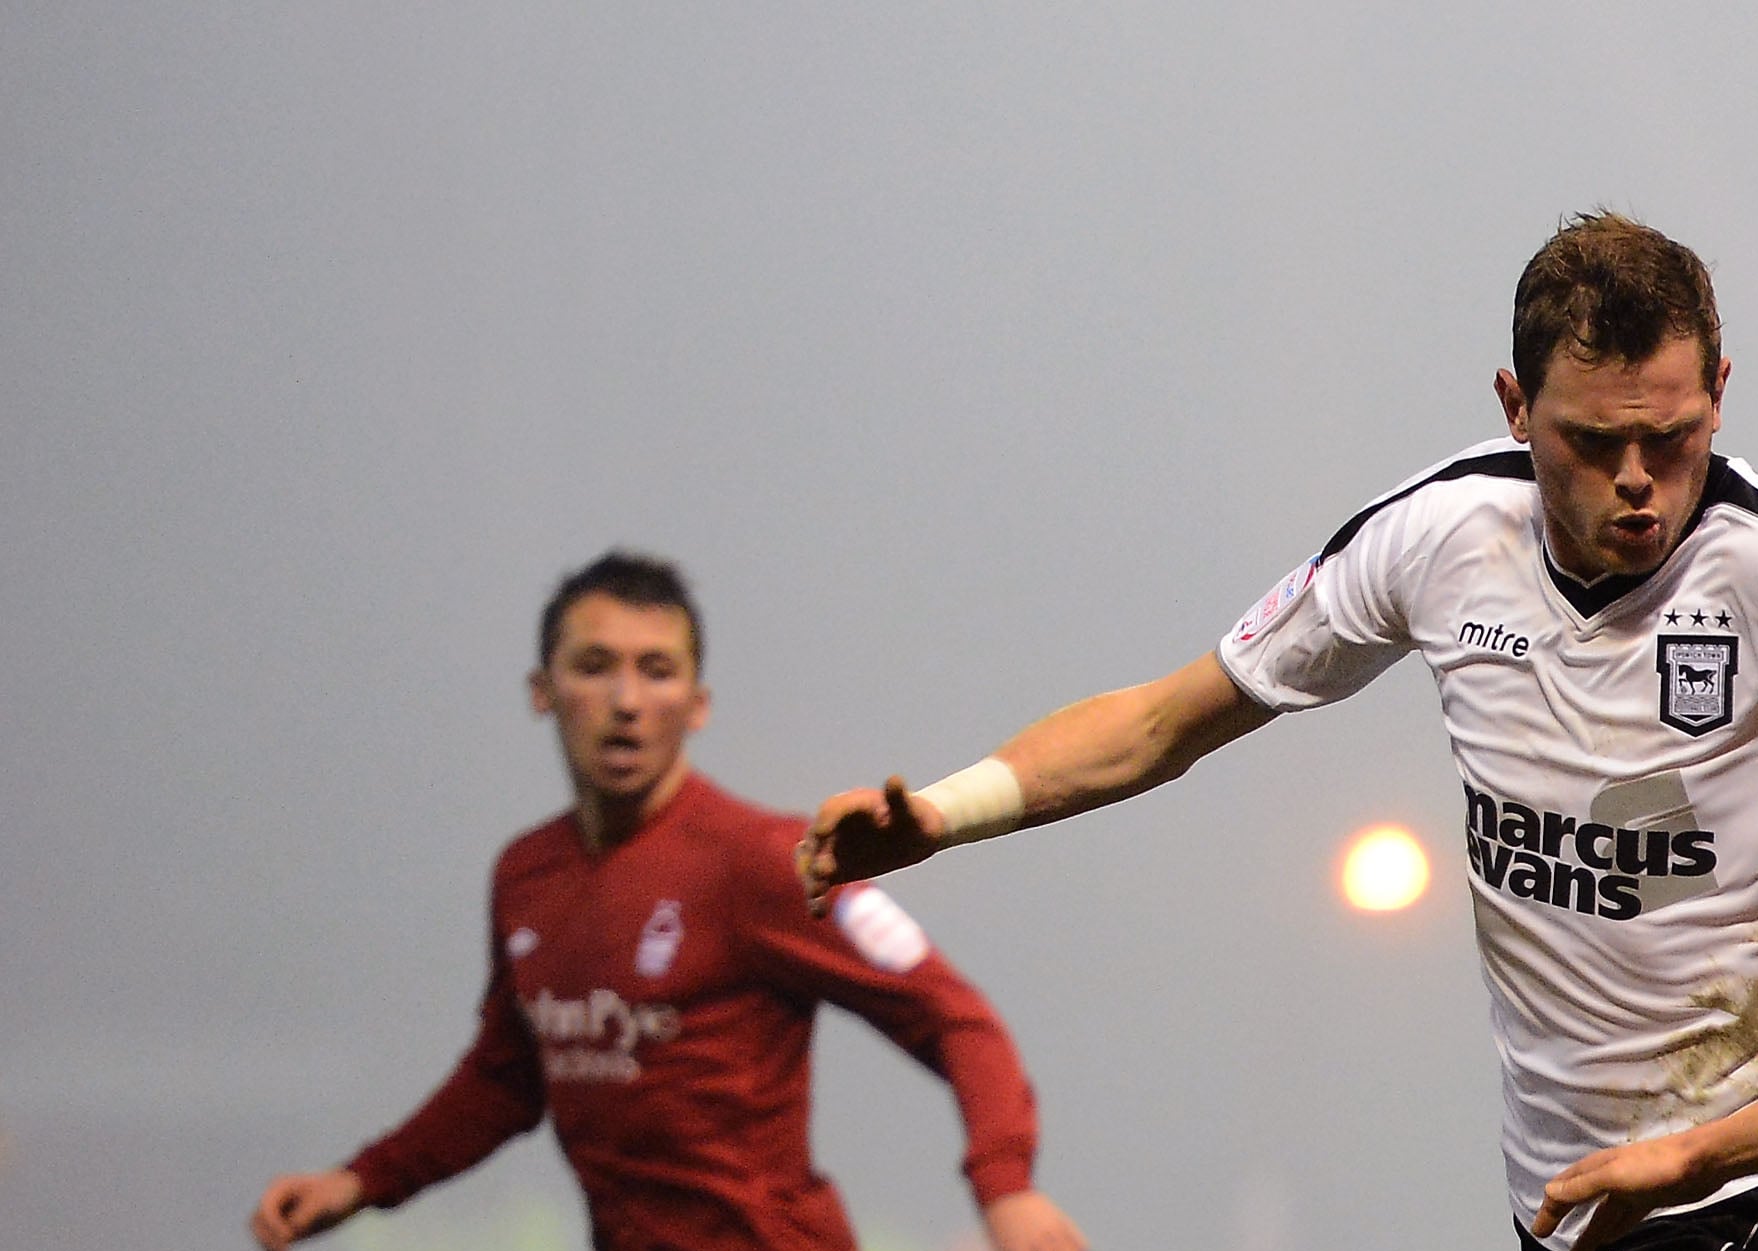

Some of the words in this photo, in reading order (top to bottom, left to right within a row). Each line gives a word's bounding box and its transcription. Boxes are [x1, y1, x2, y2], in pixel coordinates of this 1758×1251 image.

[1459, 622, 1529, 657] mitre
[1464, 781, 1717, 877] marcus
[1467, 828, 1642, 921] evans
